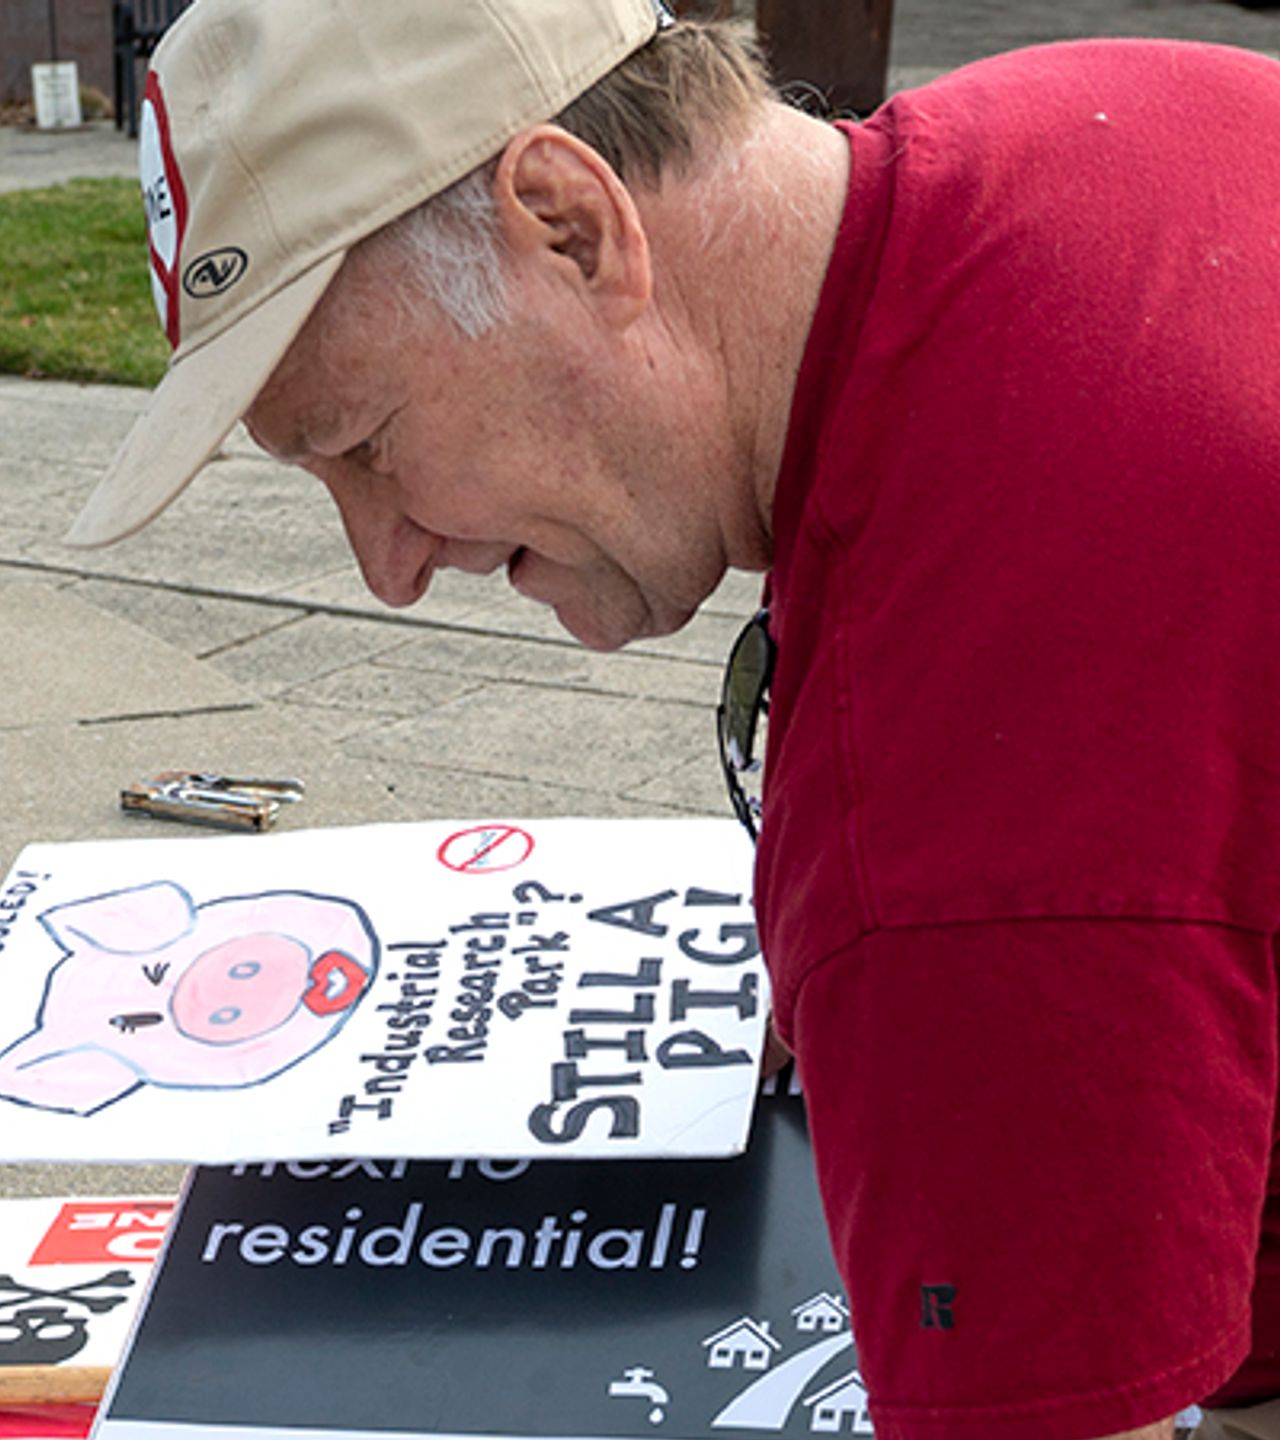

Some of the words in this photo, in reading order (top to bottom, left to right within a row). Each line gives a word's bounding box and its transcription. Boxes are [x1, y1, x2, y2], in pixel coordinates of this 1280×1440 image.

[424, 911, 510, 1064] Research
[587, 889, 678, 937] A
[656, 886, 761, 1069] PIG!
[328, 938, 448, 1135] "Industrial
[528, 956, 663, 1144] STILL
[201, 1204, 707, 1270] residential!
